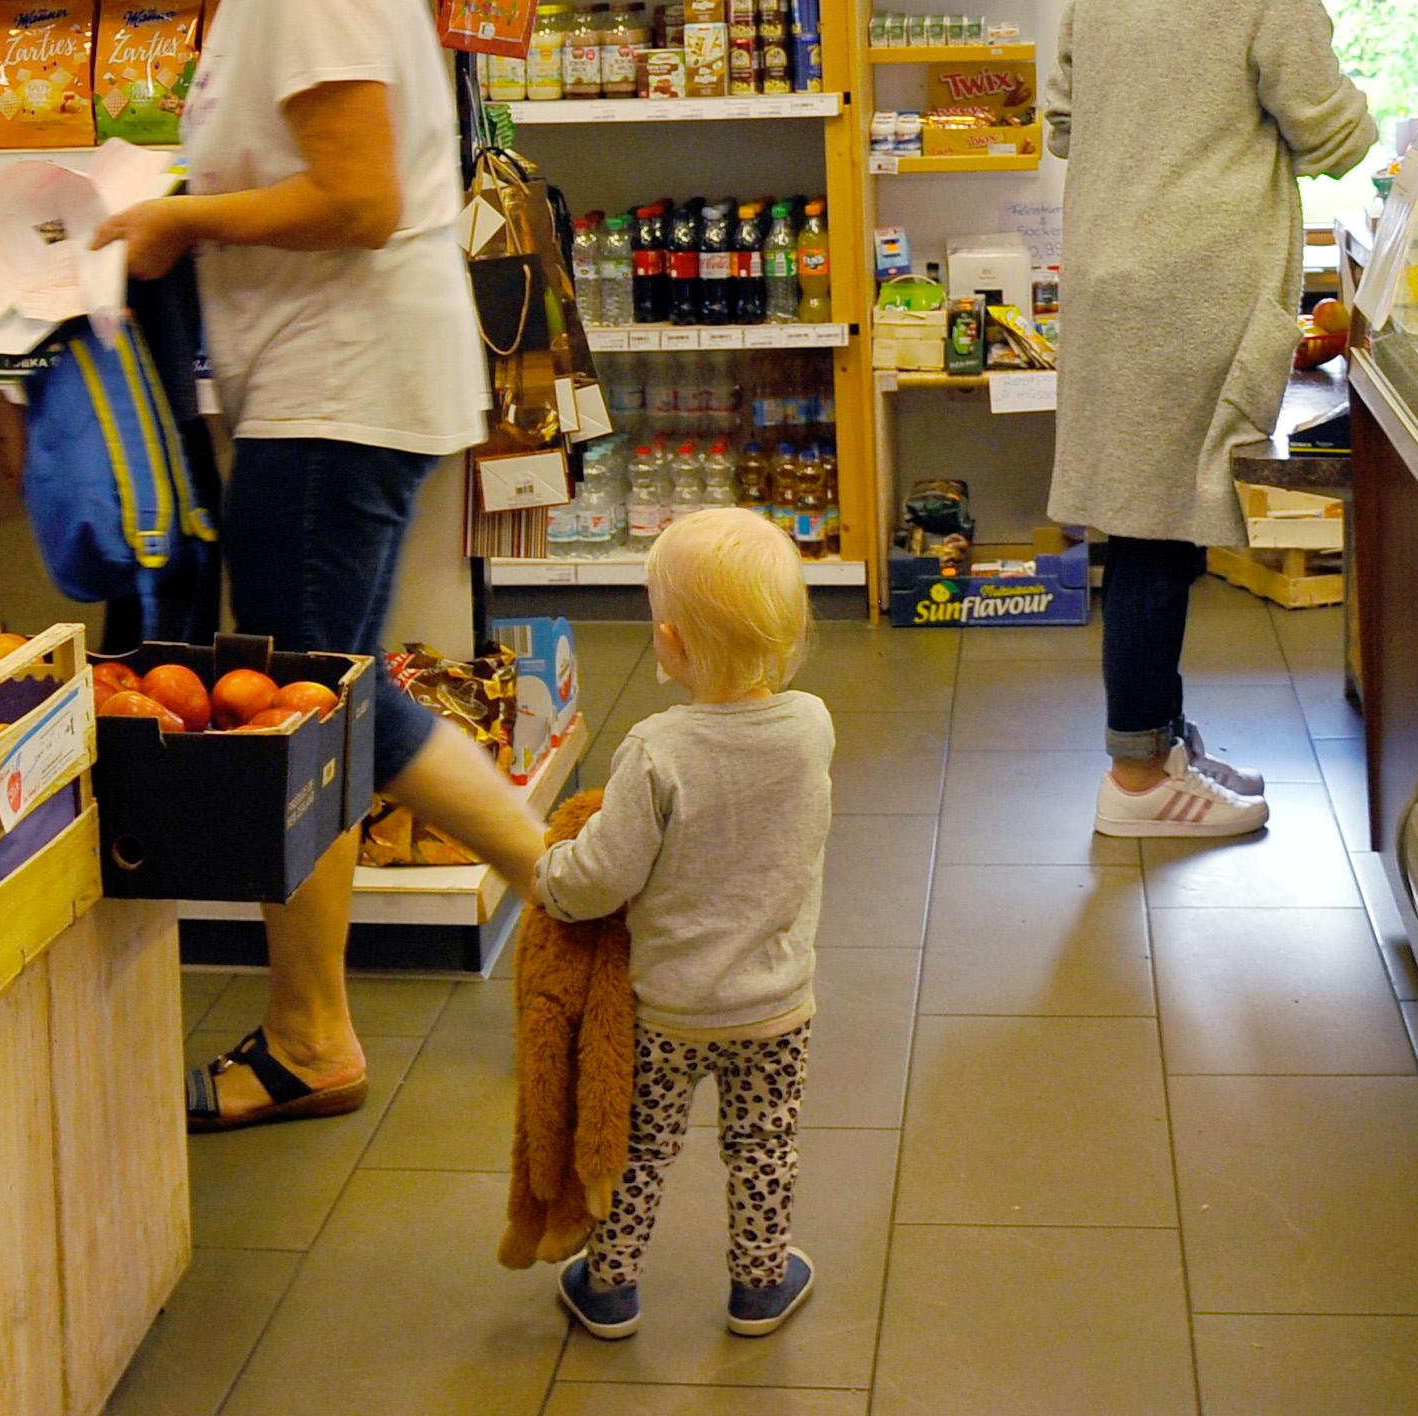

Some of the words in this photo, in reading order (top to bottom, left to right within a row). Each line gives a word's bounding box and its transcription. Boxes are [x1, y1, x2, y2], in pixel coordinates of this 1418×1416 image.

[14, 8, 69, 27] Manner
[941, 67, 1015, 101] Twix
[913, 592, 1054, 625] Sunflavour
